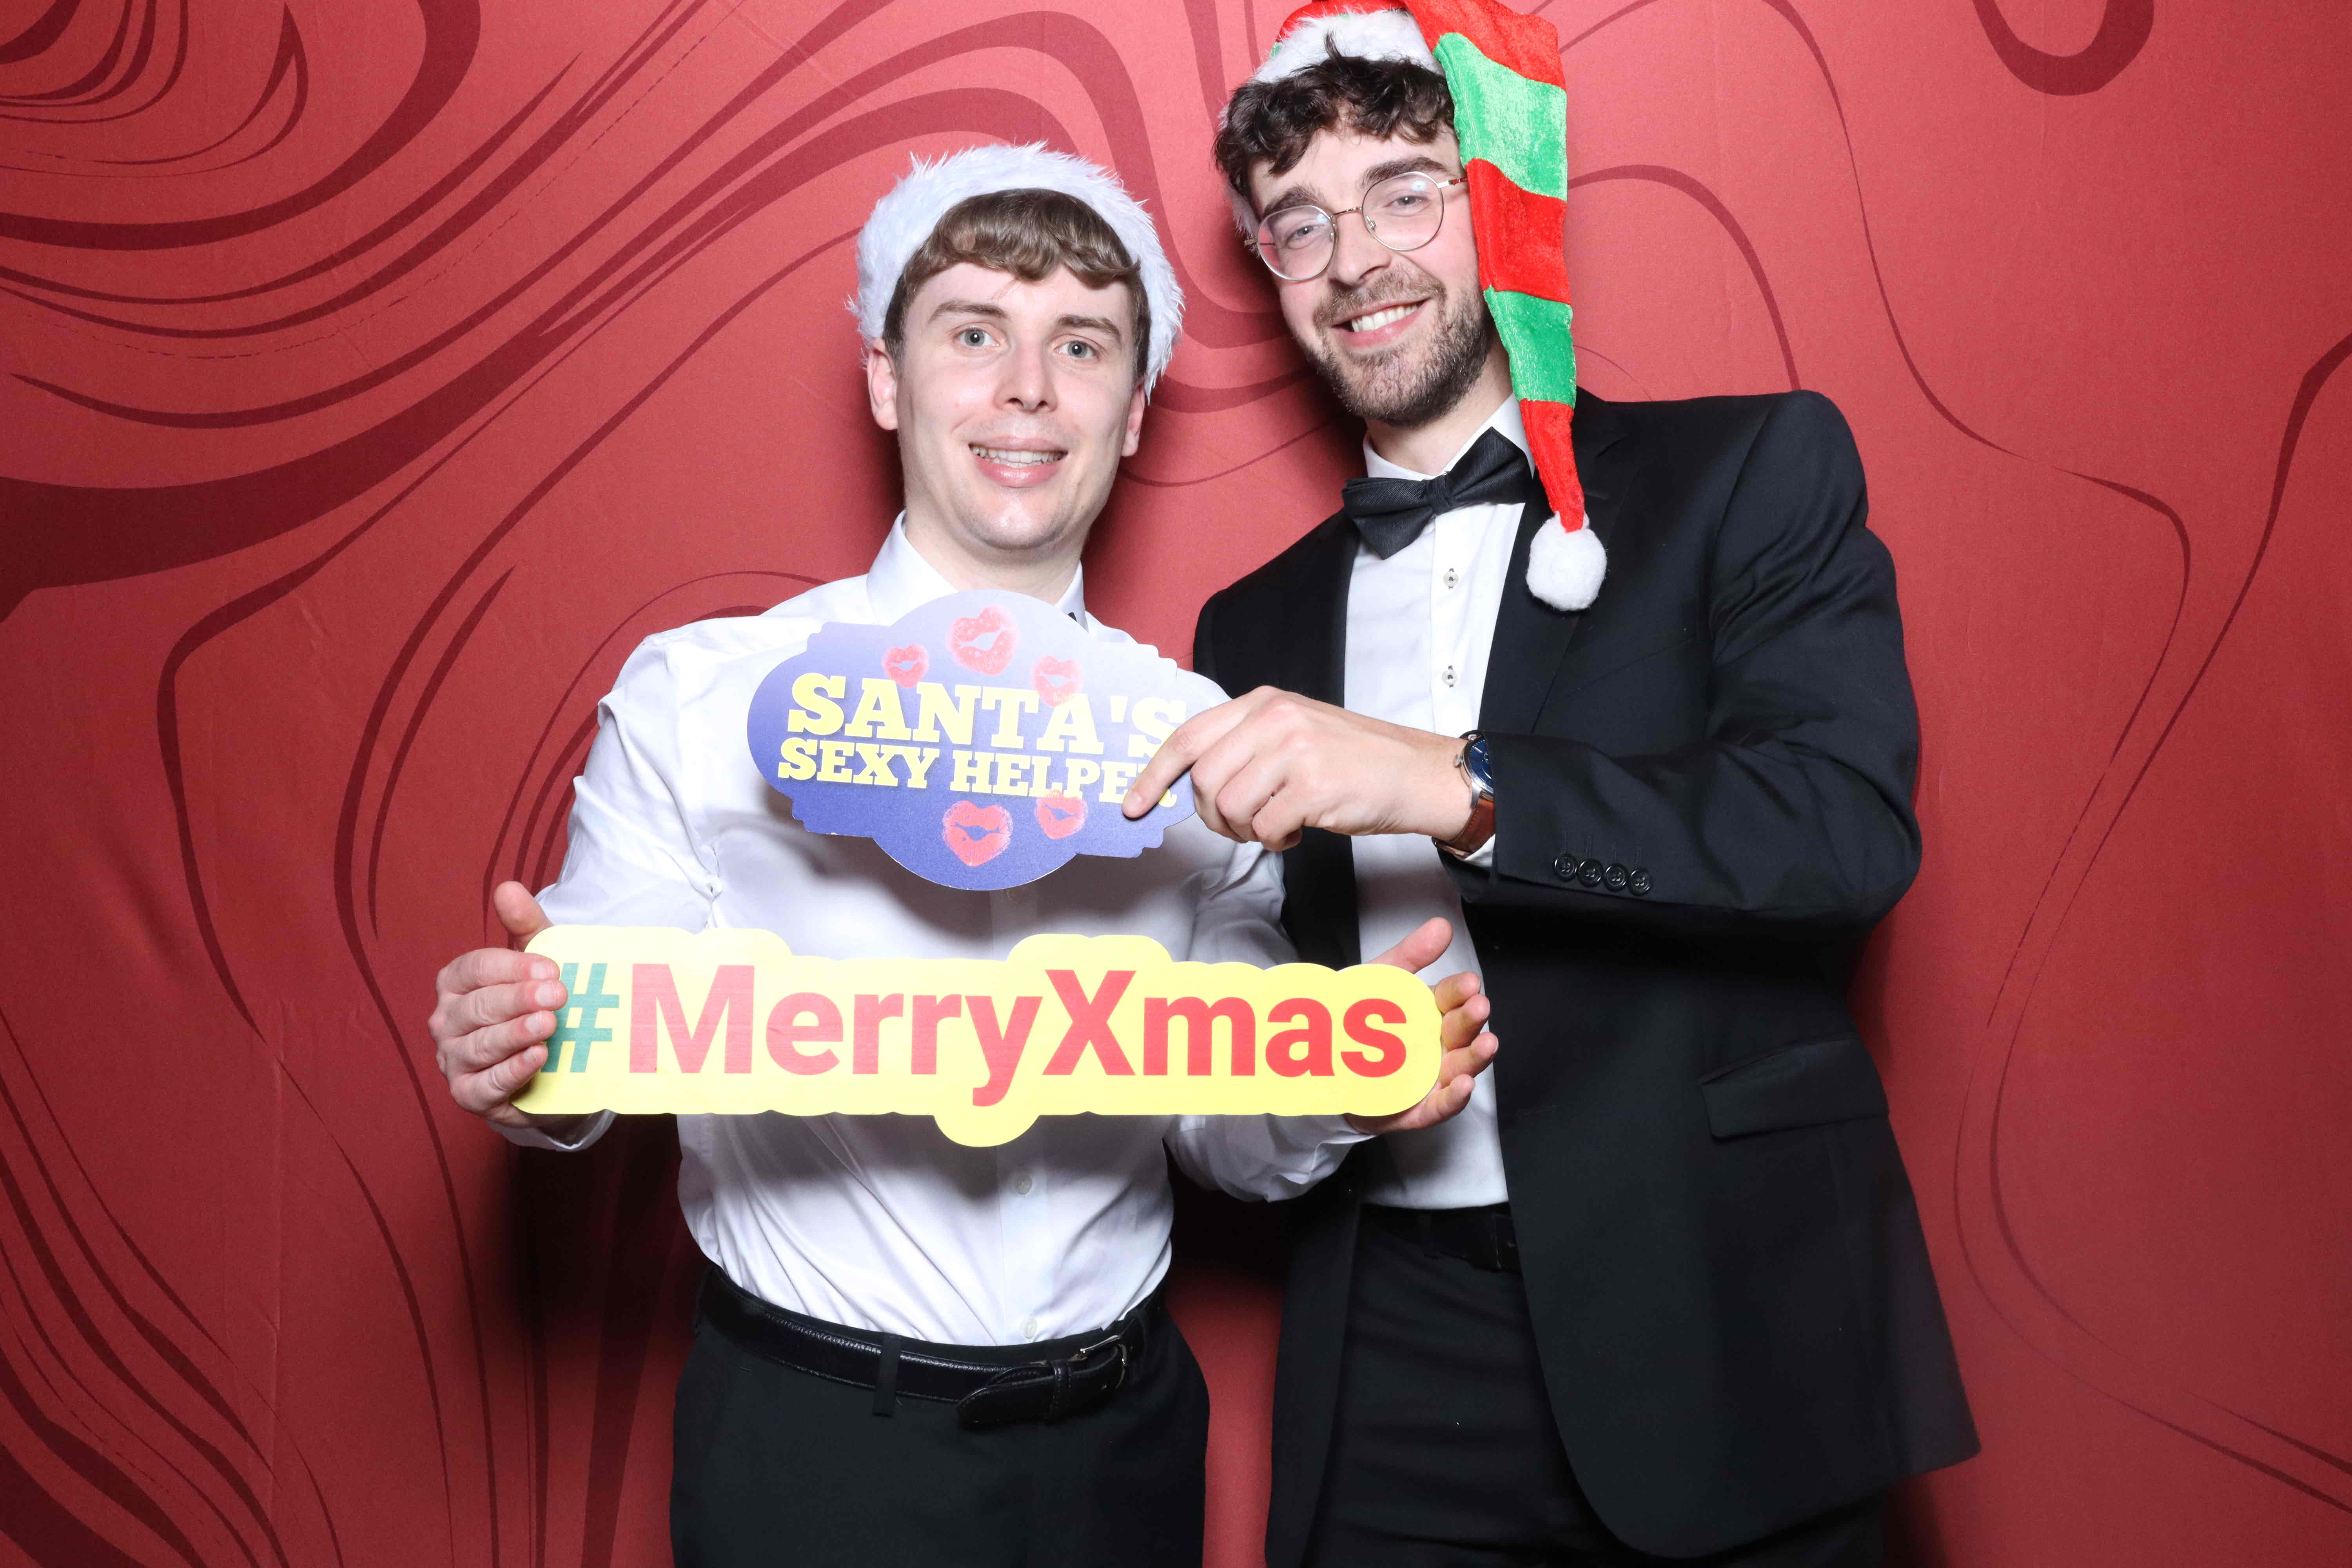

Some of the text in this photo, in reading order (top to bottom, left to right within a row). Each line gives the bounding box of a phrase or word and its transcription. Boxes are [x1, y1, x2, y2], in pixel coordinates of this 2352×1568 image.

[788, 673, 1187, 759] SANTA'S
[778, 737, 1177, 808] SEXY HELPE
[540, 963, 1407, 1107] #MerryXmas
